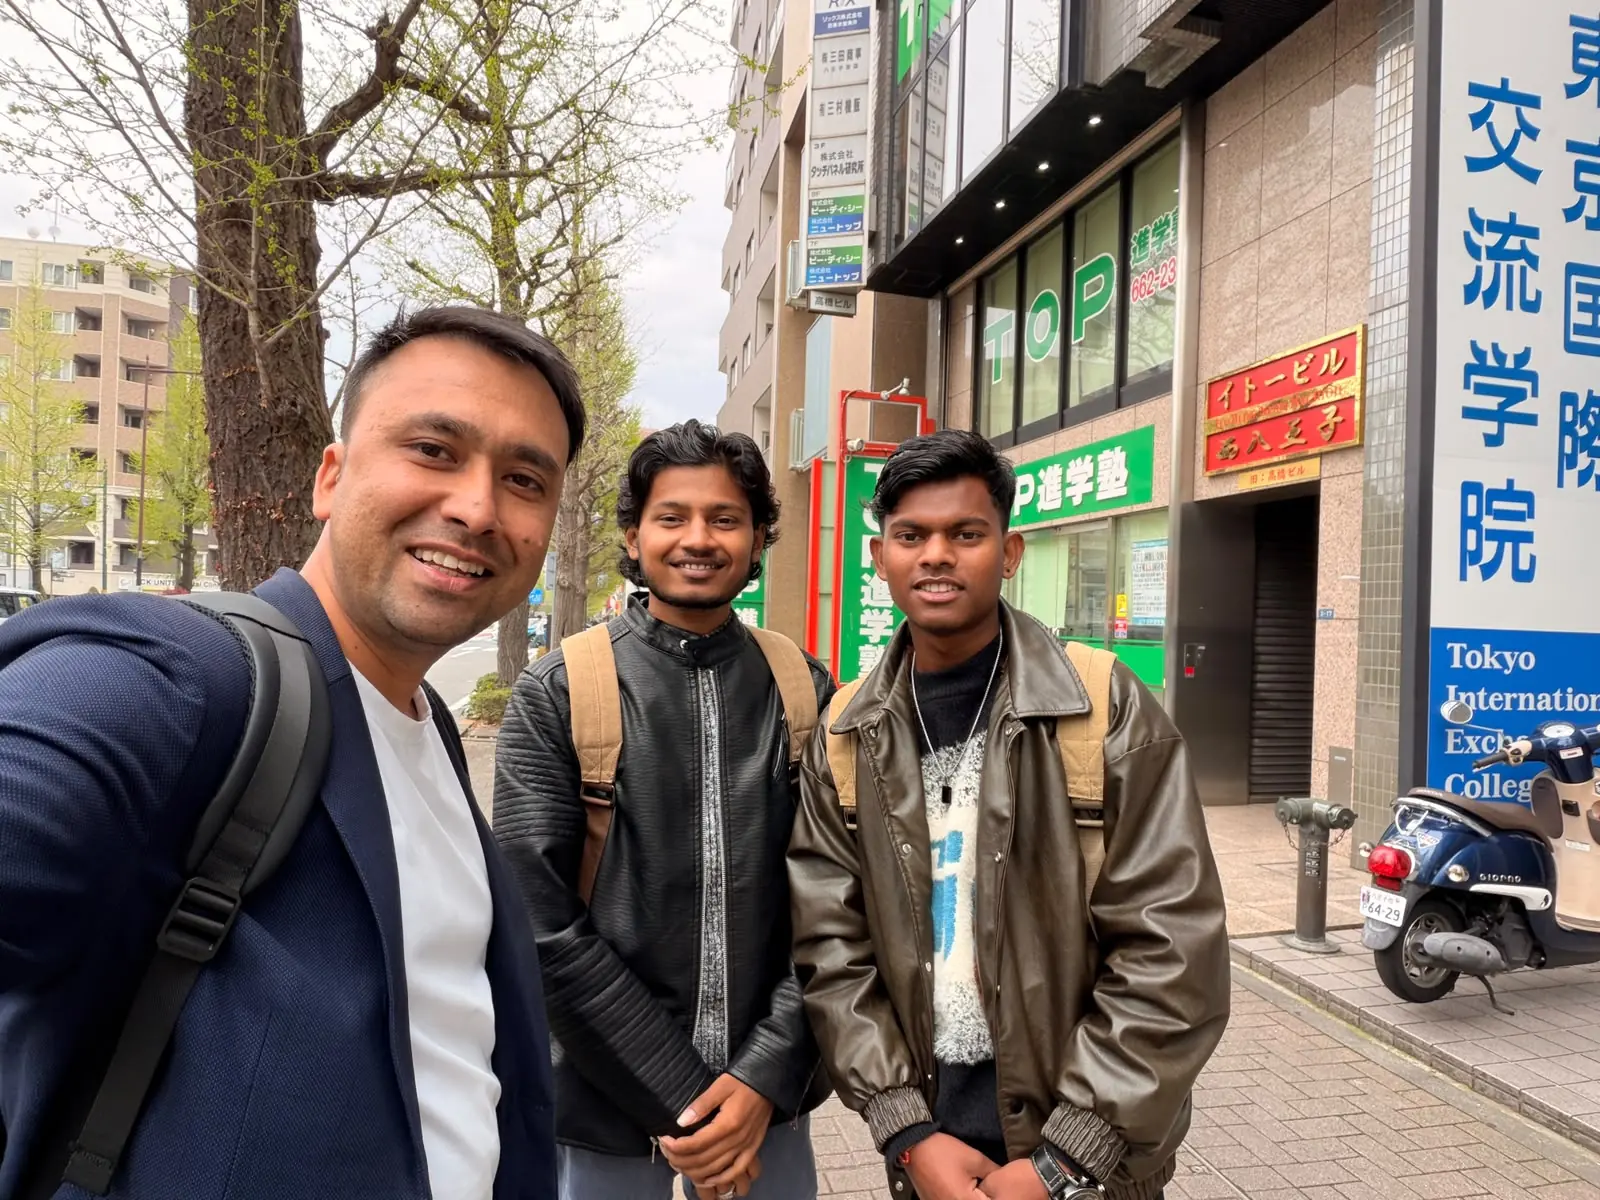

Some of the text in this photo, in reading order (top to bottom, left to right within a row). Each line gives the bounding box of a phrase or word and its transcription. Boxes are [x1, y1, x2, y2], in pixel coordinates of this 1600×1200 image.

[811, 160, 864, 178] タッチパネル研究所
[820, 150, 854, 161] 株式会社
[811, 221, 862, 233] ニュートップ
[808, 272, 860, 283] ニュートップ
[984, 253, 1116, 385] TOP
[1458, 77, 1543, 584] 交流学院
[1217, 347, 1346, 410] イトービル
[1013, 445, 1128, 516] P進学塾
[1447, 642, 1536, 675] Tokyo
[1444, 729, 1529, 754] Exch
[1445, 773, 1532, 802] Colleg
[1368, 902, 1401, 922] 64-29
